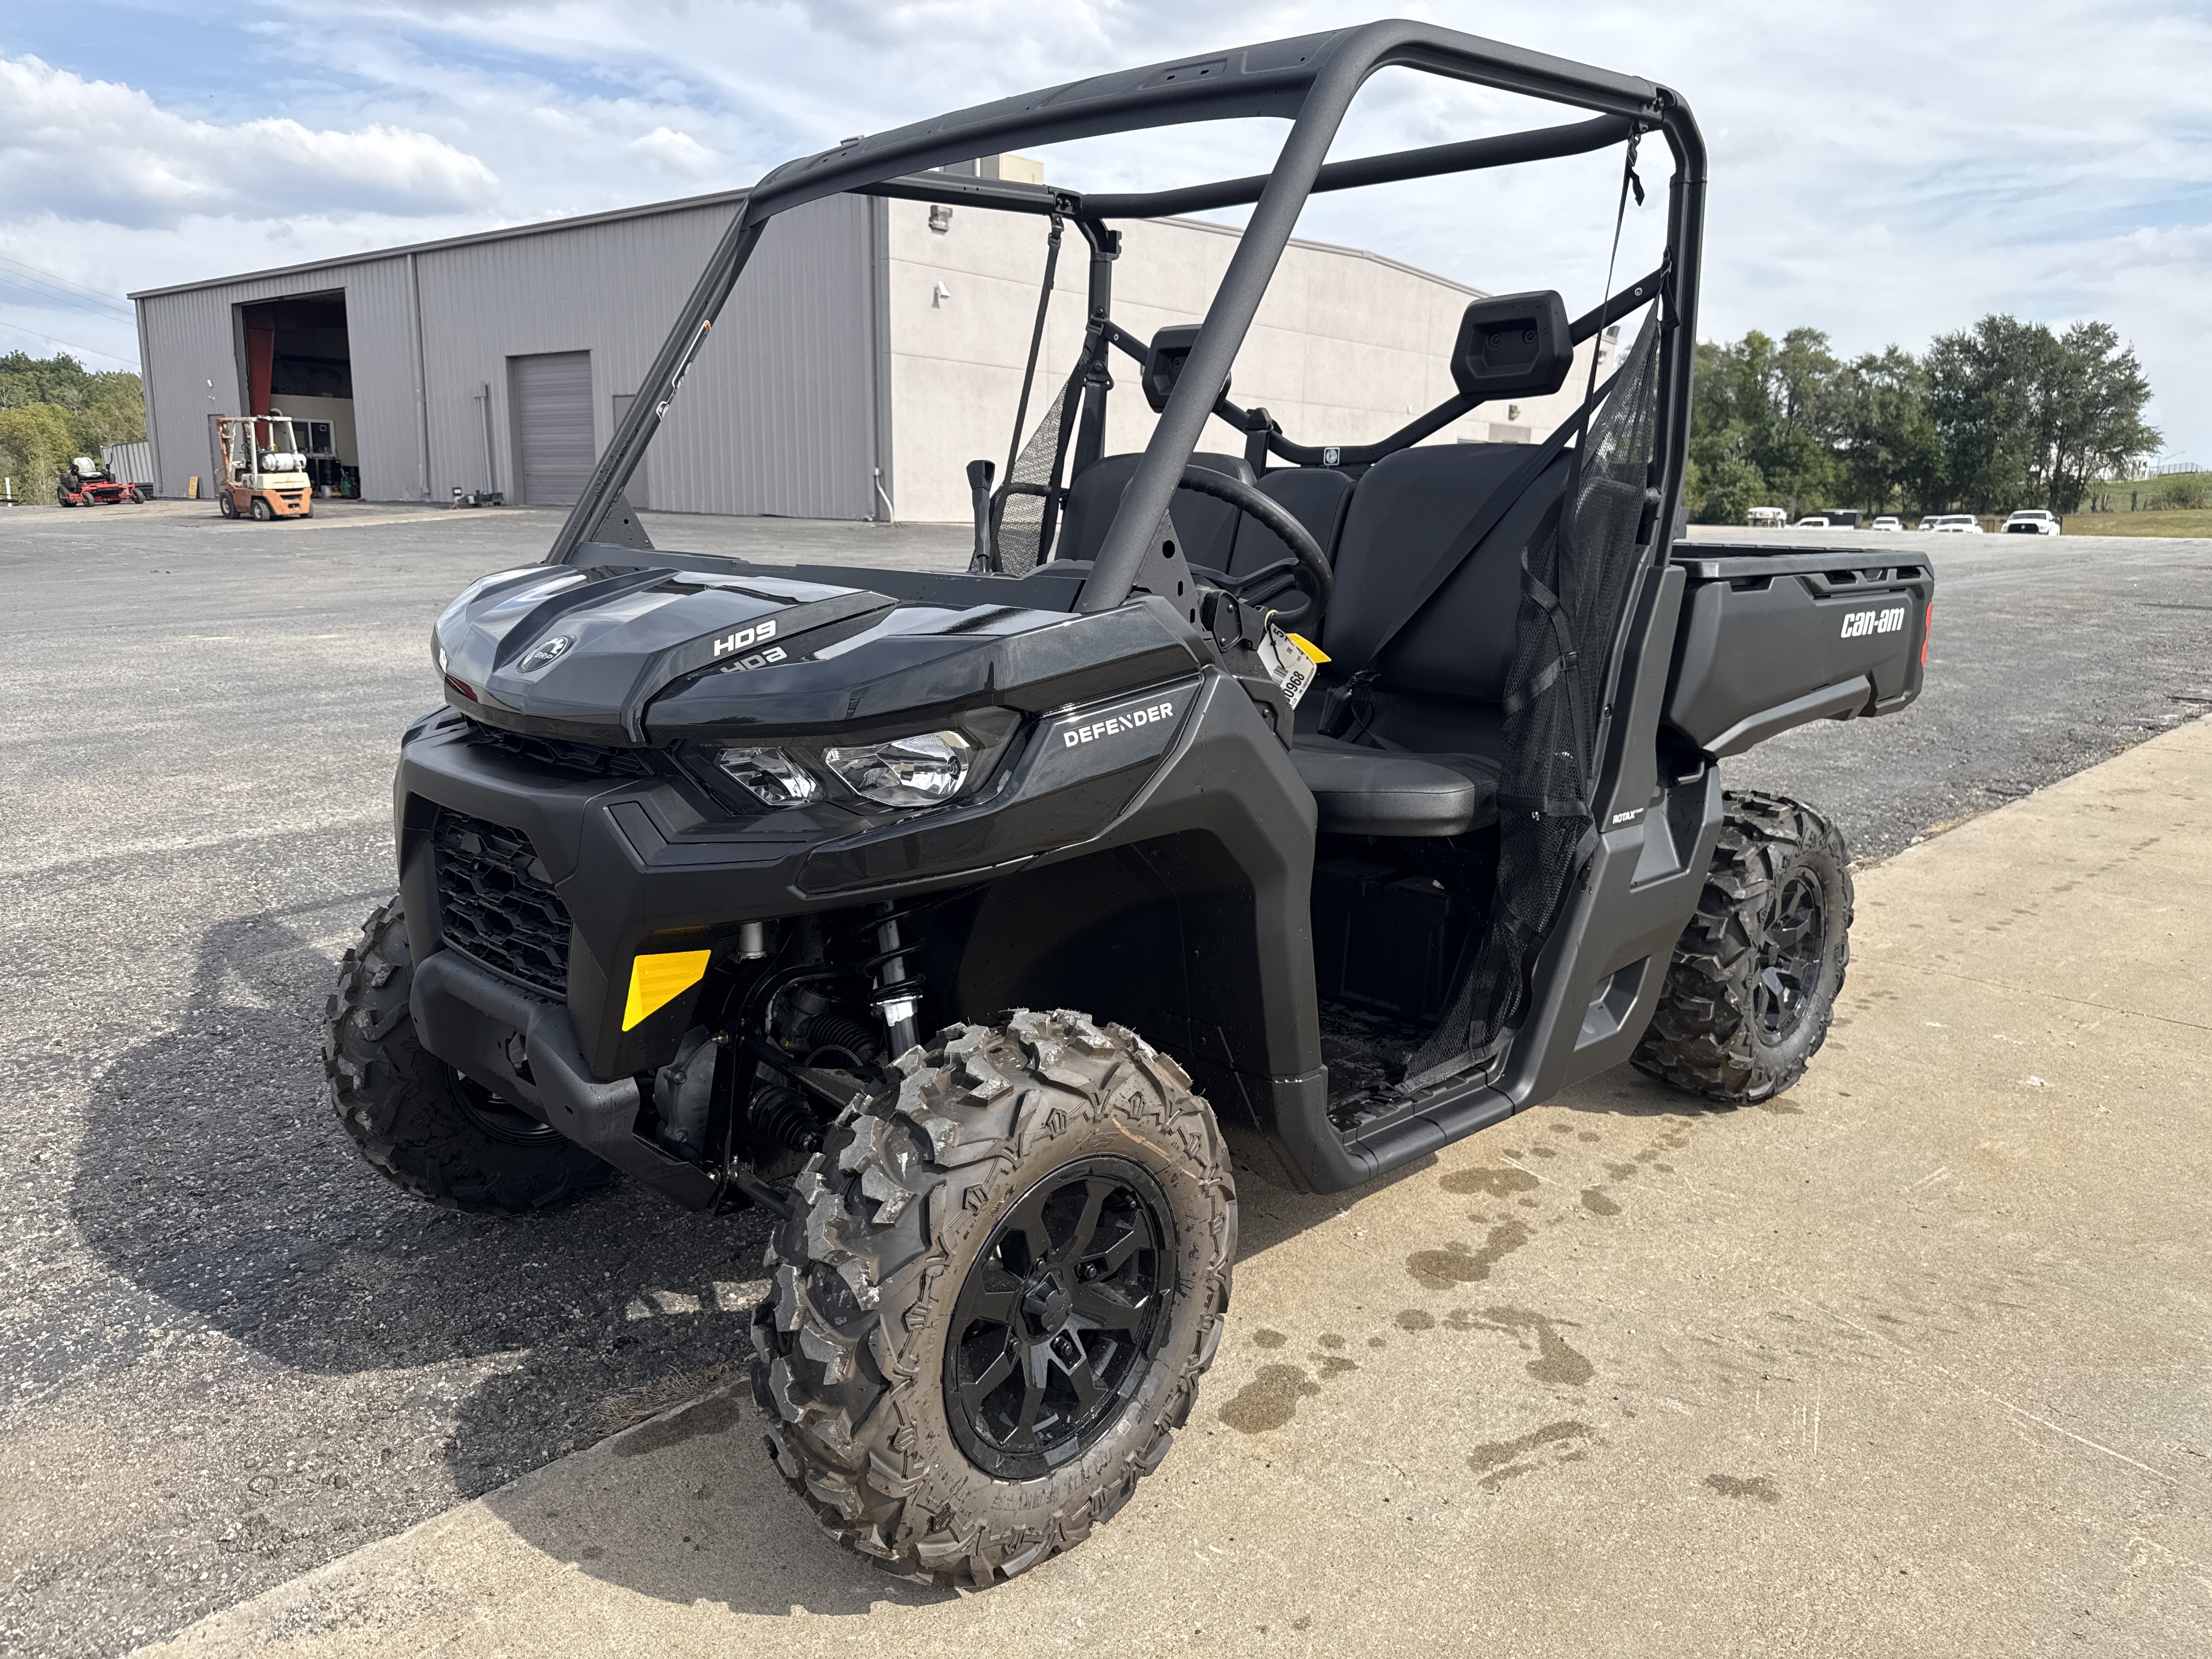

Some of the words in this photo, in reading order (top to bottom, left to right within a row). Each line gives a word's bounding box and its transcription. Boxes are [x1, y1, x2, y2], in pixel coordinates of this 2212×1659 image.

[714, 620, 776, 657] HD9
[1841, 607, 1905, 638] can-am
[1282, 671, 1305, 701] 0968
[1063, 703, 1173, 747] DEFENDER
[1612, 810, 1635, 824] ROTAX
[924, 1313, 941, 1363] RADIAL
